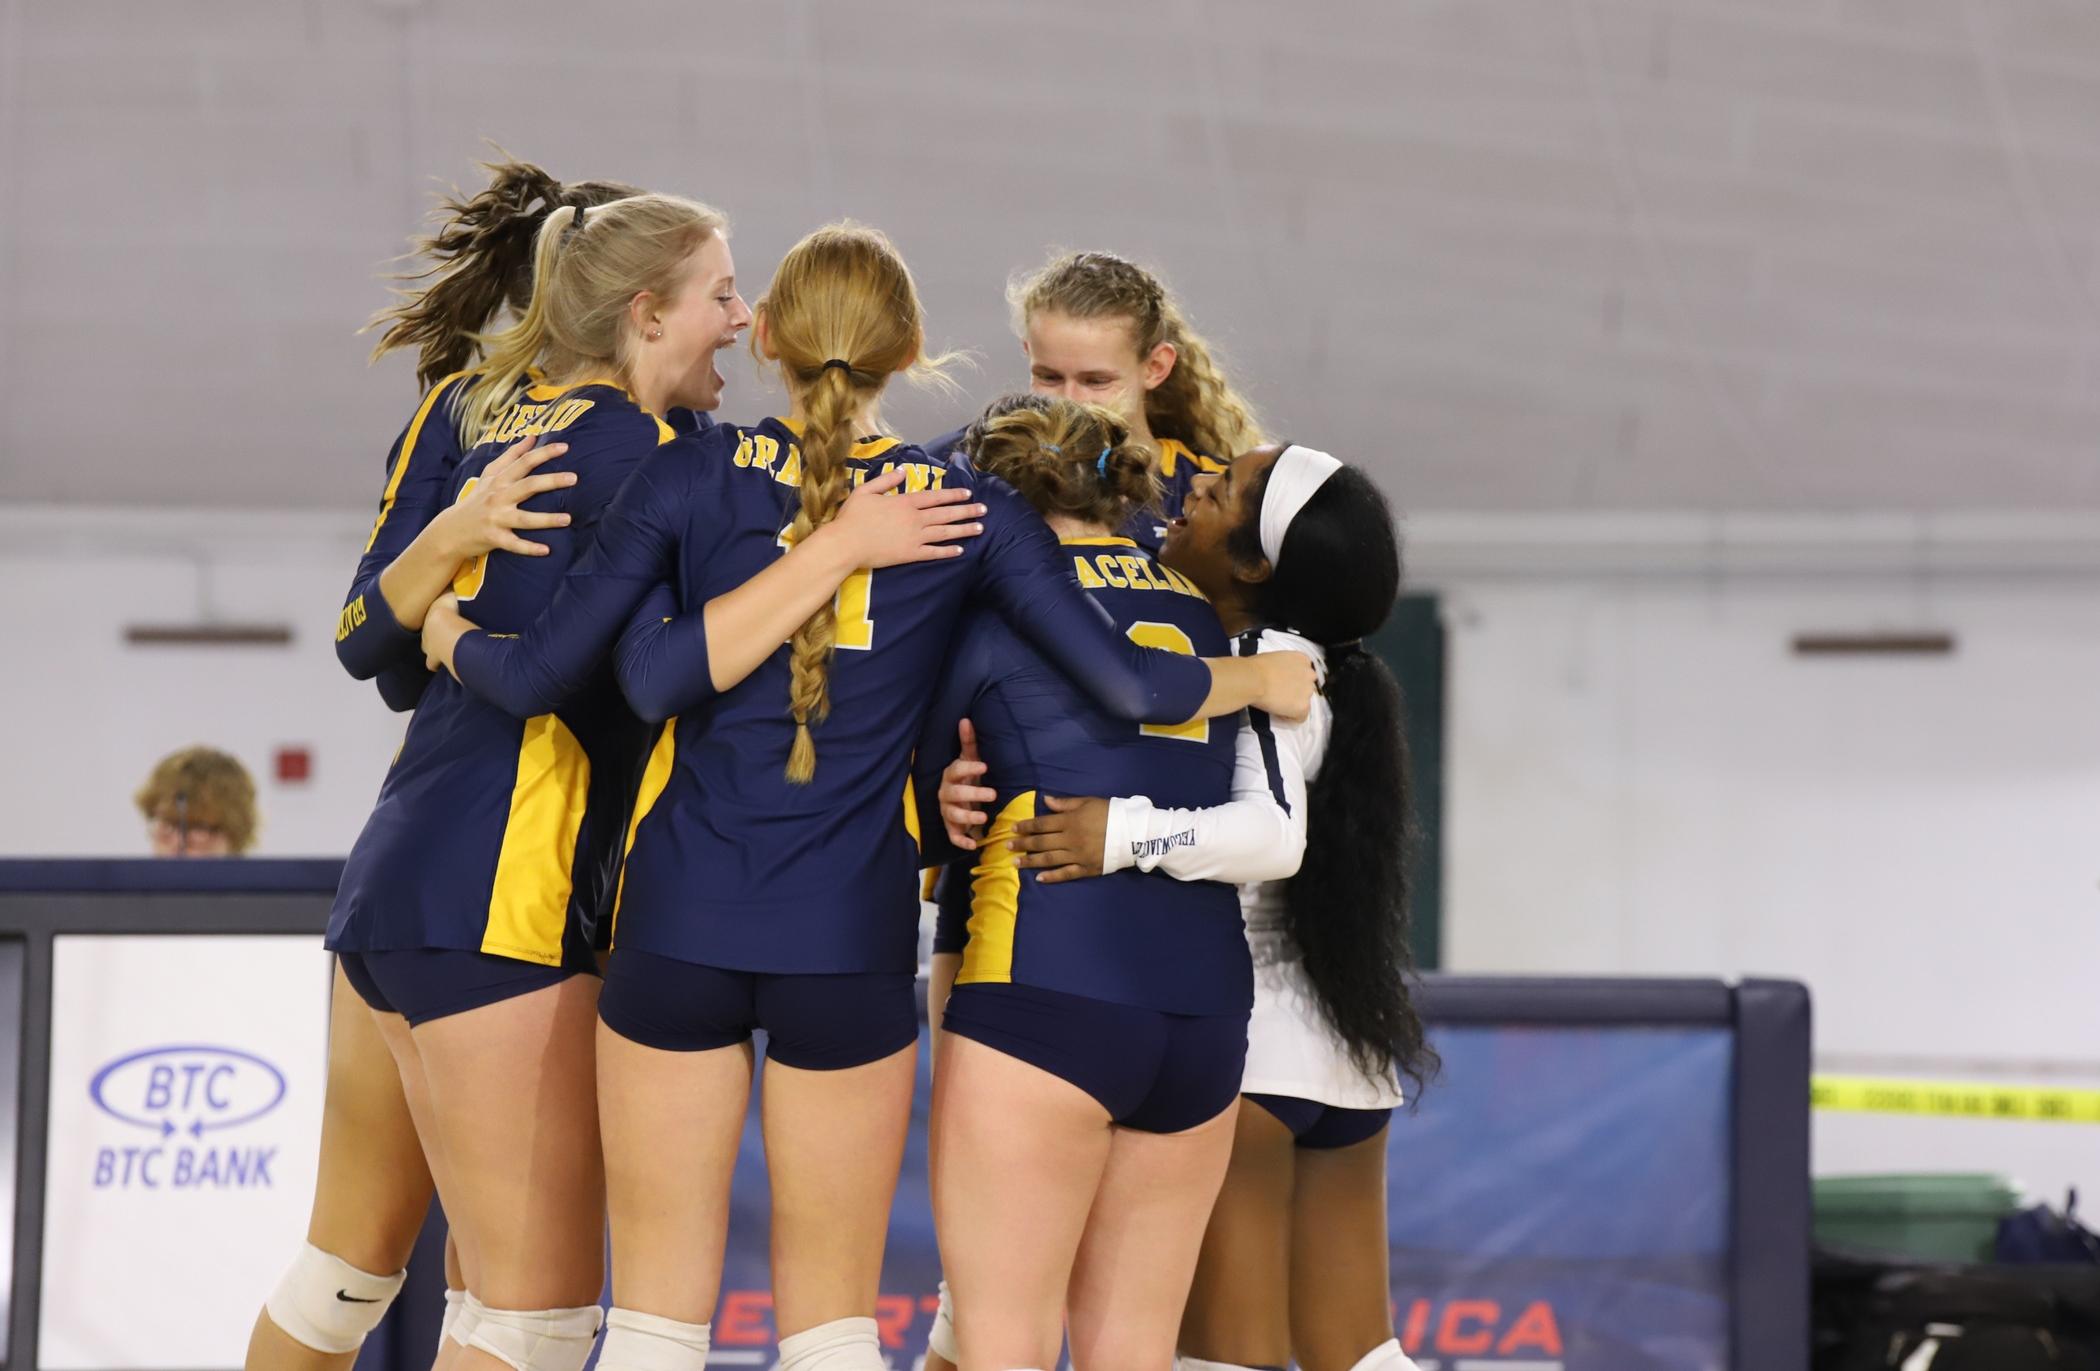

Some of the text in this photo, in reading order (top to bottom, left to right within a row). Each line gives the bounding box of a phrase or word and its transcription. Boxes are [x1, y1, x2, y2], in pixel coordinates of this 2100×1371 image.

[145, 1064, 237, 1110] BTC
[94, 1147, 278, 1188] BTC BANK
[1392, 1297, 1565, 1356] ICA
